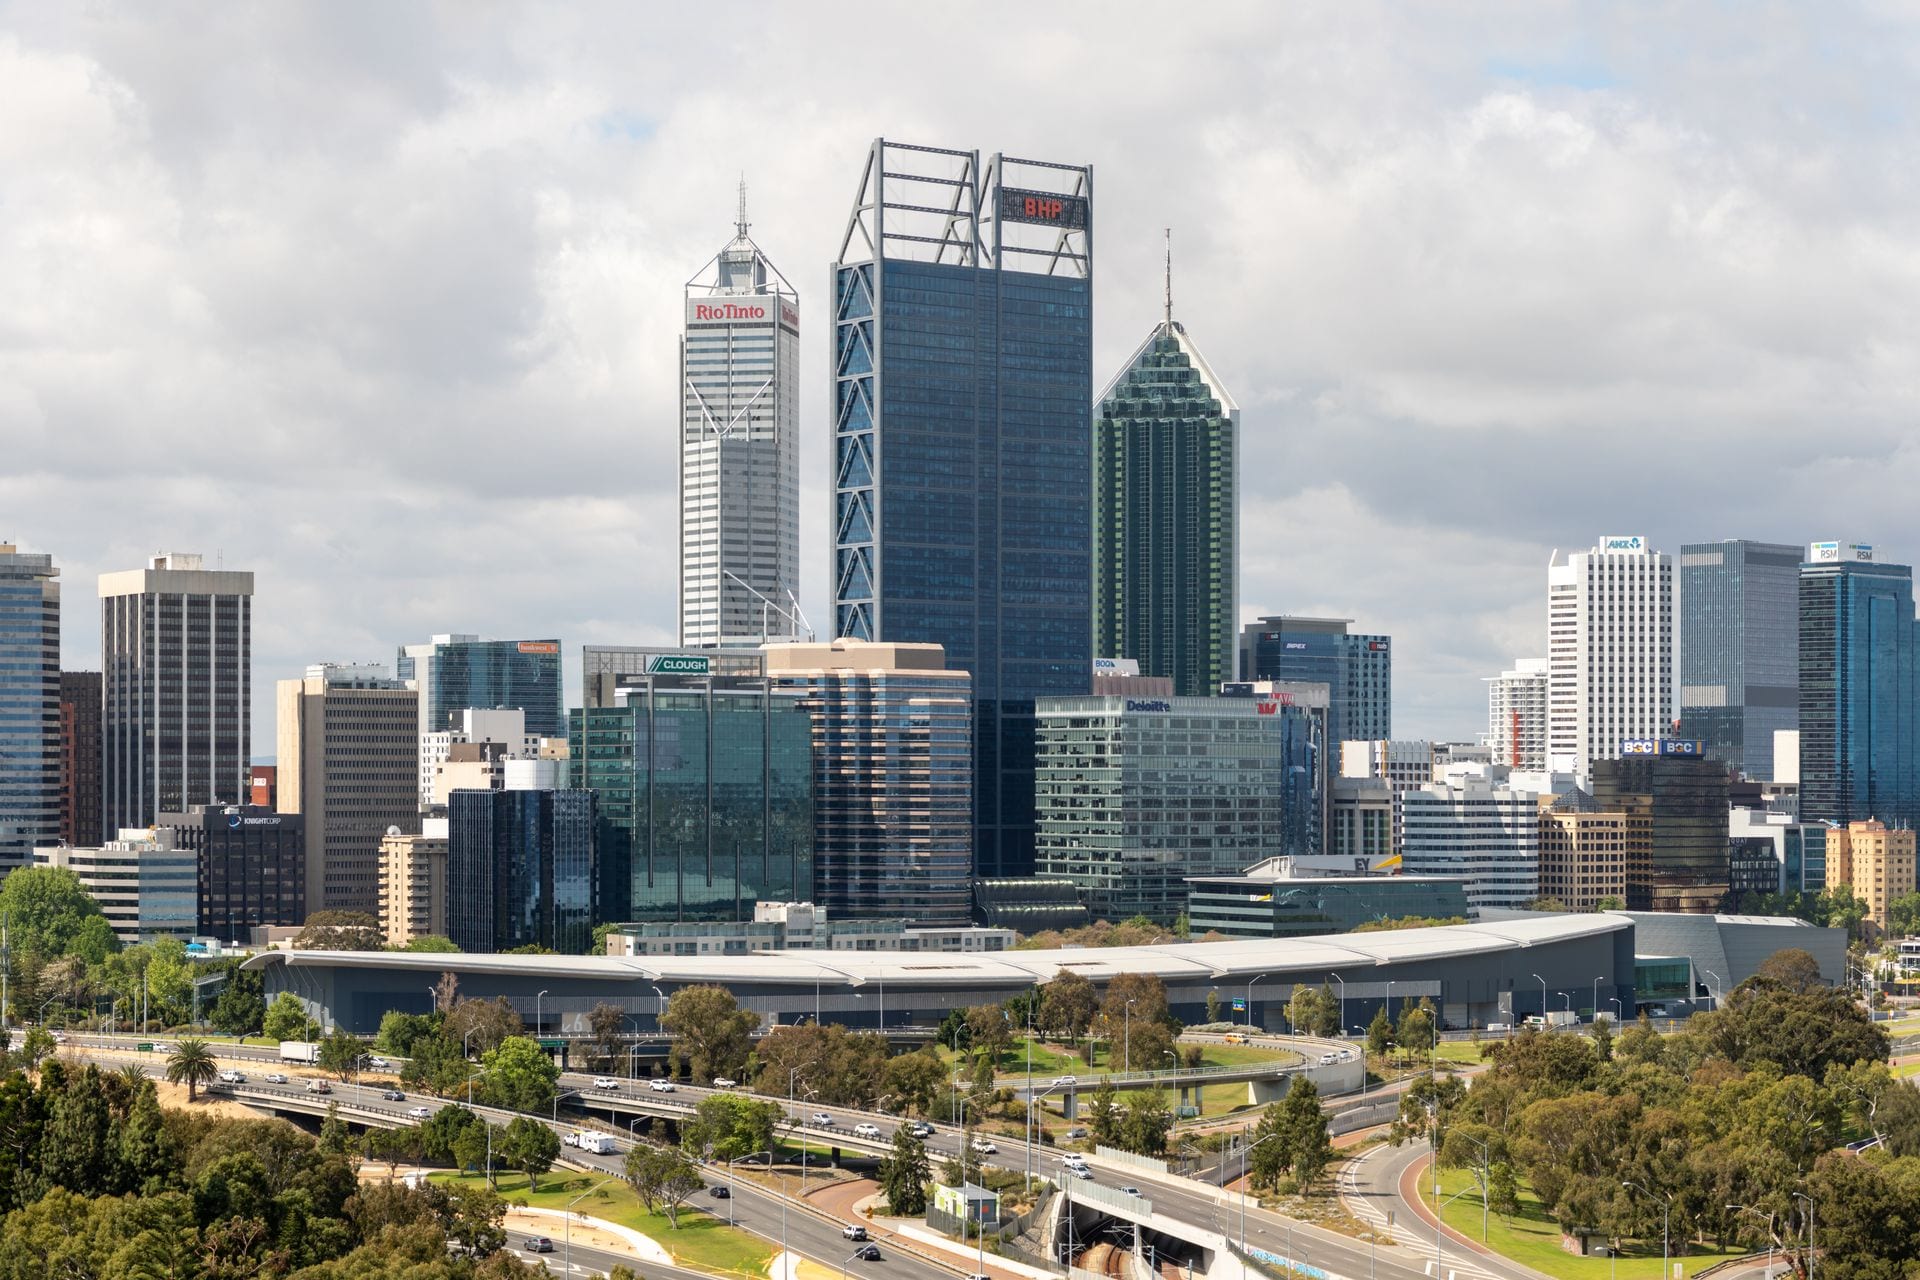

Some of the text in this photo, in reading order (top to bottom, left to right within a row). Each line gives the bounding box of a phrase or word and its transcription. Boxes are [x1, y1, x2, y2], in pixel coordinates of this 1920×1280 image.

[1024, 198, 1062, 219] BHP
[1607, 541, 1630, 549] ANZ
[1820, 549, 1837, 559] RSM
[1856, 551, 1872, 560] RSM
[663, 660, 706, 670] CLOUGH
[1127, 700, 1170, 713] Deloitte
[1622, 741, 1653, 753] BGC
[1666, 742, 1692, 753] BGC
[244, 817, 281, 825] KNIGHTCORP
[1354, 857, 1371, 870] EY
[574, 1013, 583, 1031] 6
